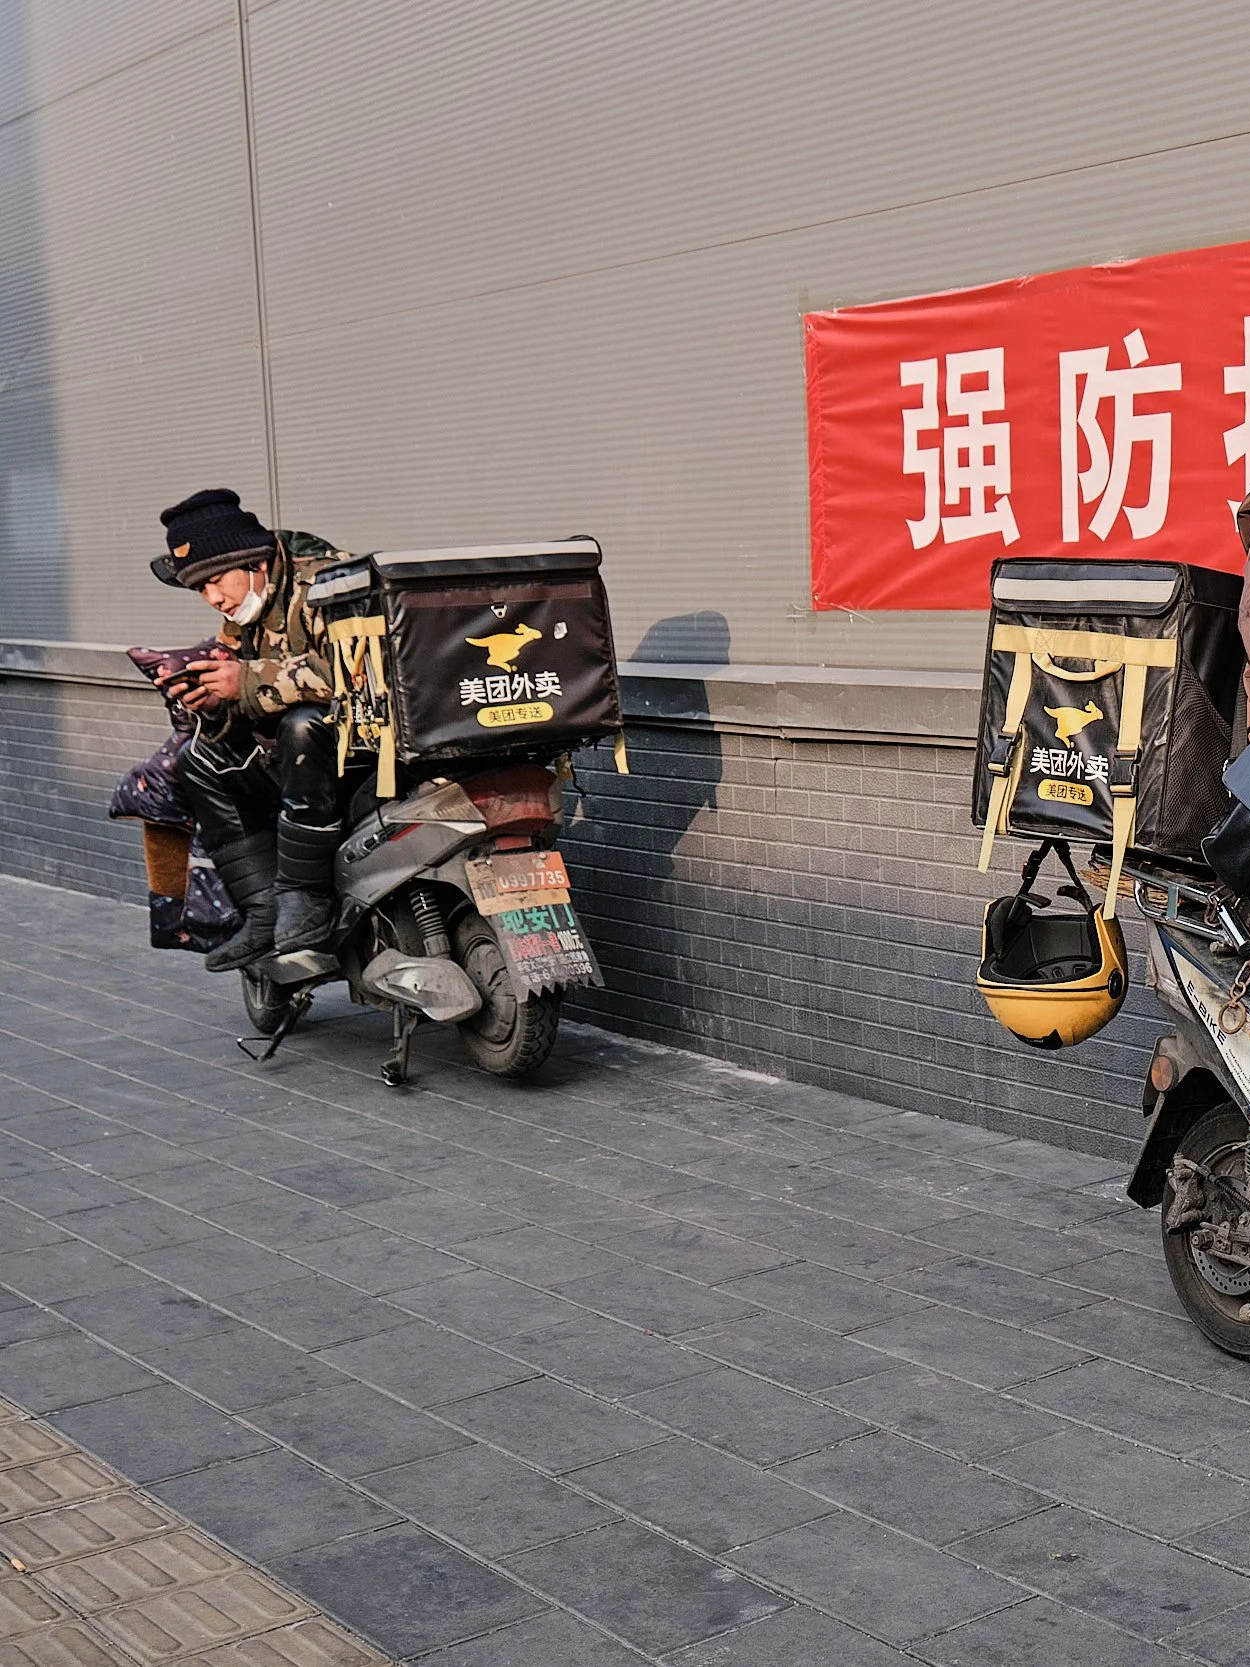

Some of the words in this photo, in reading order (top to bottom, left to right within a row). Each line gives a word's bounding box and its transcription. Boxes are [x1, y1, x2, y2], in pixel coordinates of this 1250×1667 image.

[458, 670, 563, 706] 美团外卖
[488, 706, 543, 724] 美团专送
[1029, 746, 1109, 784] 美团外卖
[1046, 783, 1088, 802] 美团专送
[499, 869, 566, 889] 0997735
[1186, 980, 1227, 1046] E-BIKE
